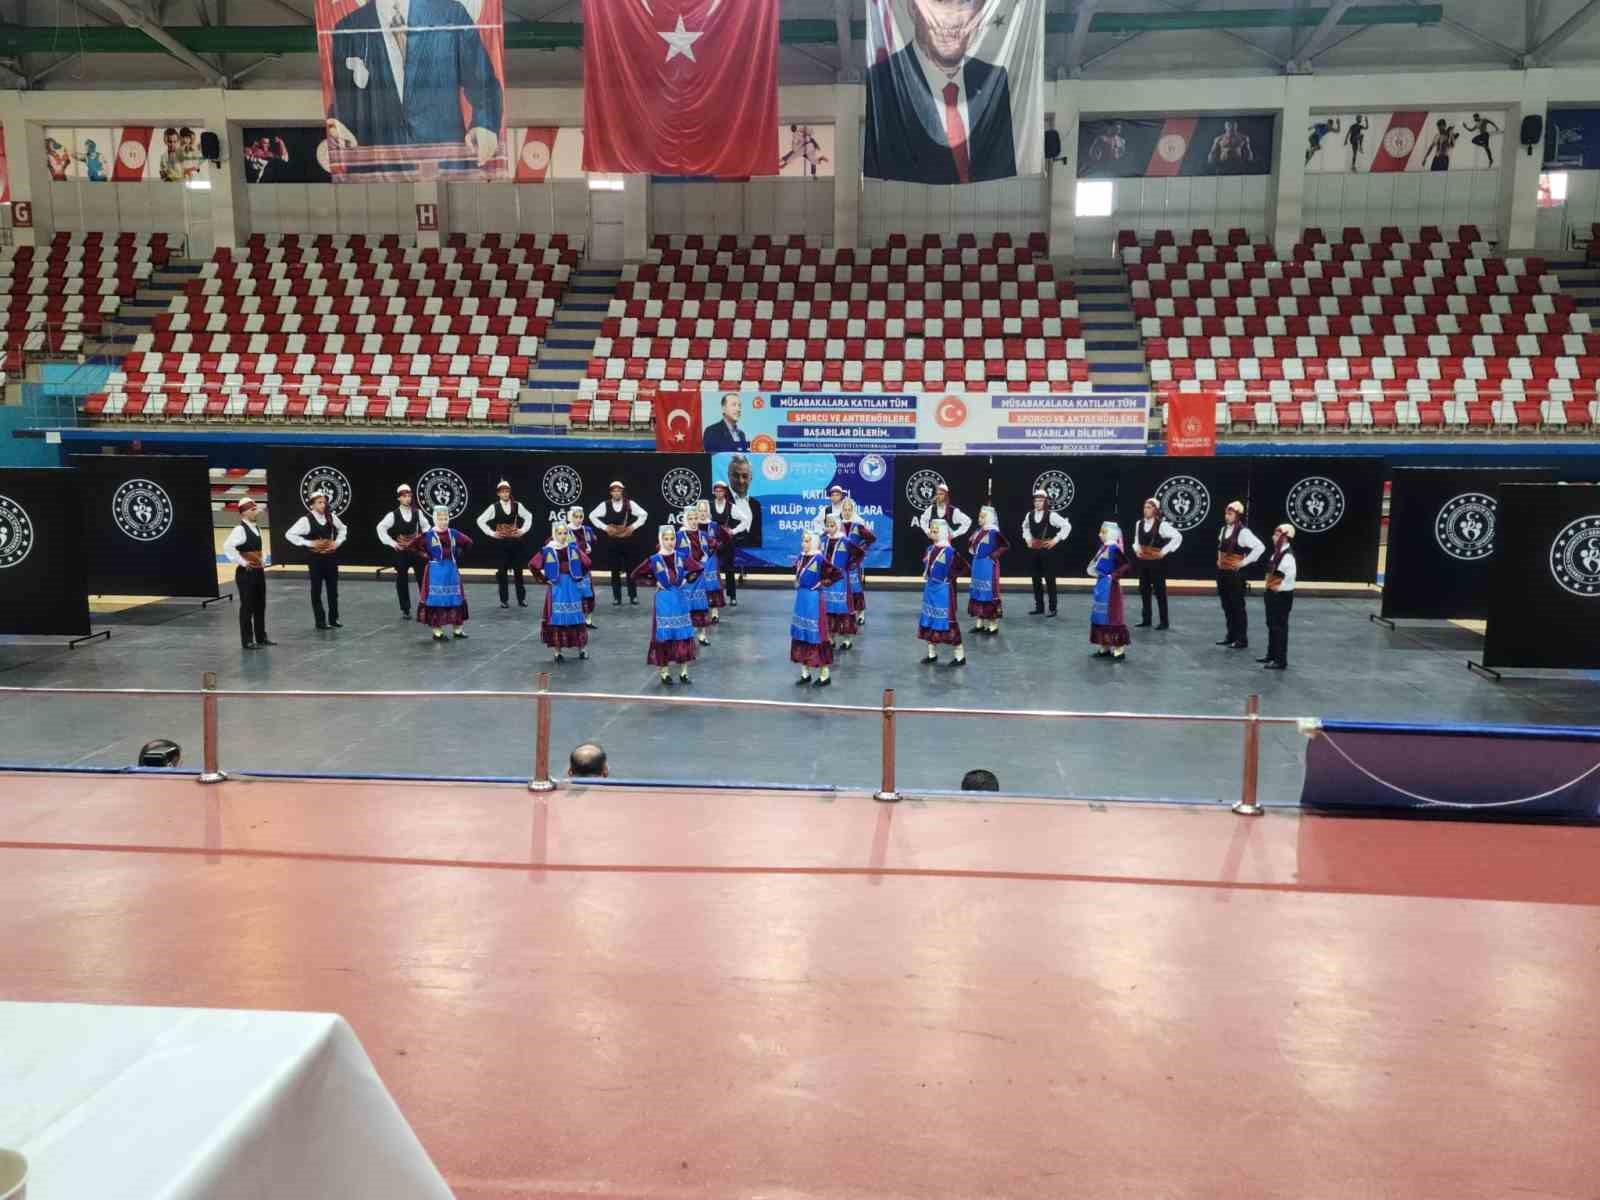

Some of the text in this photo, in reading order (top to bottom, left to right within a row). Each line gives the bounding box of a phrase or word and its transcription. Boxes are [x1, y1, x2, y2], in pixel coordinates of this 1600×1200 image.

[15, 203, 28, 221] G
[420, 205, 433, 225] H
[780, 397, 908, 408] MÜSABAKALARA KATILAN TÜM
[1076, 399, 1114, 408] KATILAN
[1116, 398, 1137, 408] TÜM
[795, 413, 829, 422] SPORCU
[831, 414, 841, 422] VE
[803, 427, 890, 438] BAŞARILAR DİLERİM.
[770, 503, 803, 515] KULÜP
[804, 507, 817, 515] ve
